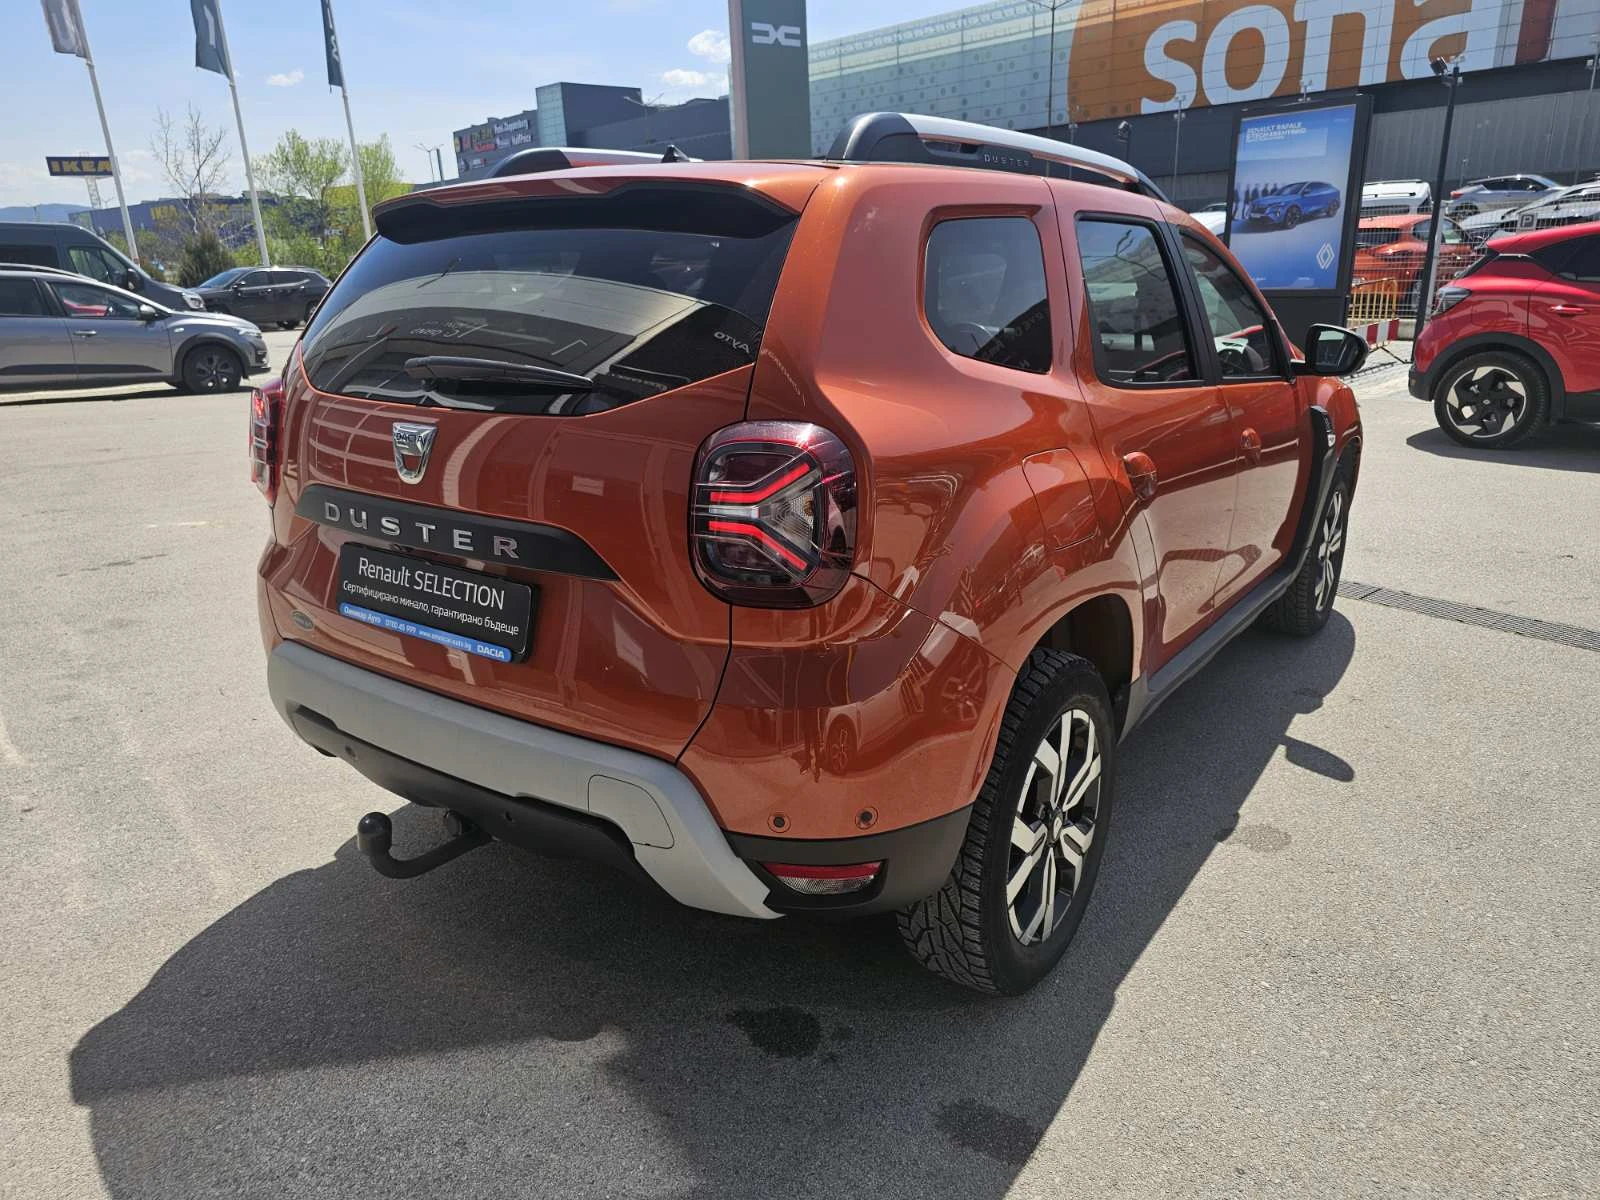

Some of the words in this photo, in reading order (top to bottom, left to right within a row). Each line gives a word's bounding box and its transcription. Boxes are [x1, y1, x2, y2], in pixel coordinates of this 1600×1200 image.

[51, 160, 113, 172] IKEA
[984, 153, 1030, 167] DUSTER
[324, 502, 519, 559] DUSTER
[358, 557, 411, 587] Renault
[413, 570, 505, 610] SELECTION
[343, 580, 398, 603] Сертифицирано
[399, 597, 429, 614] минало,
[431, 604, 483, 624] гарантирано
[484, 616, 519, 636] бъдеще
[477, 644, 505, 660] DACIA
